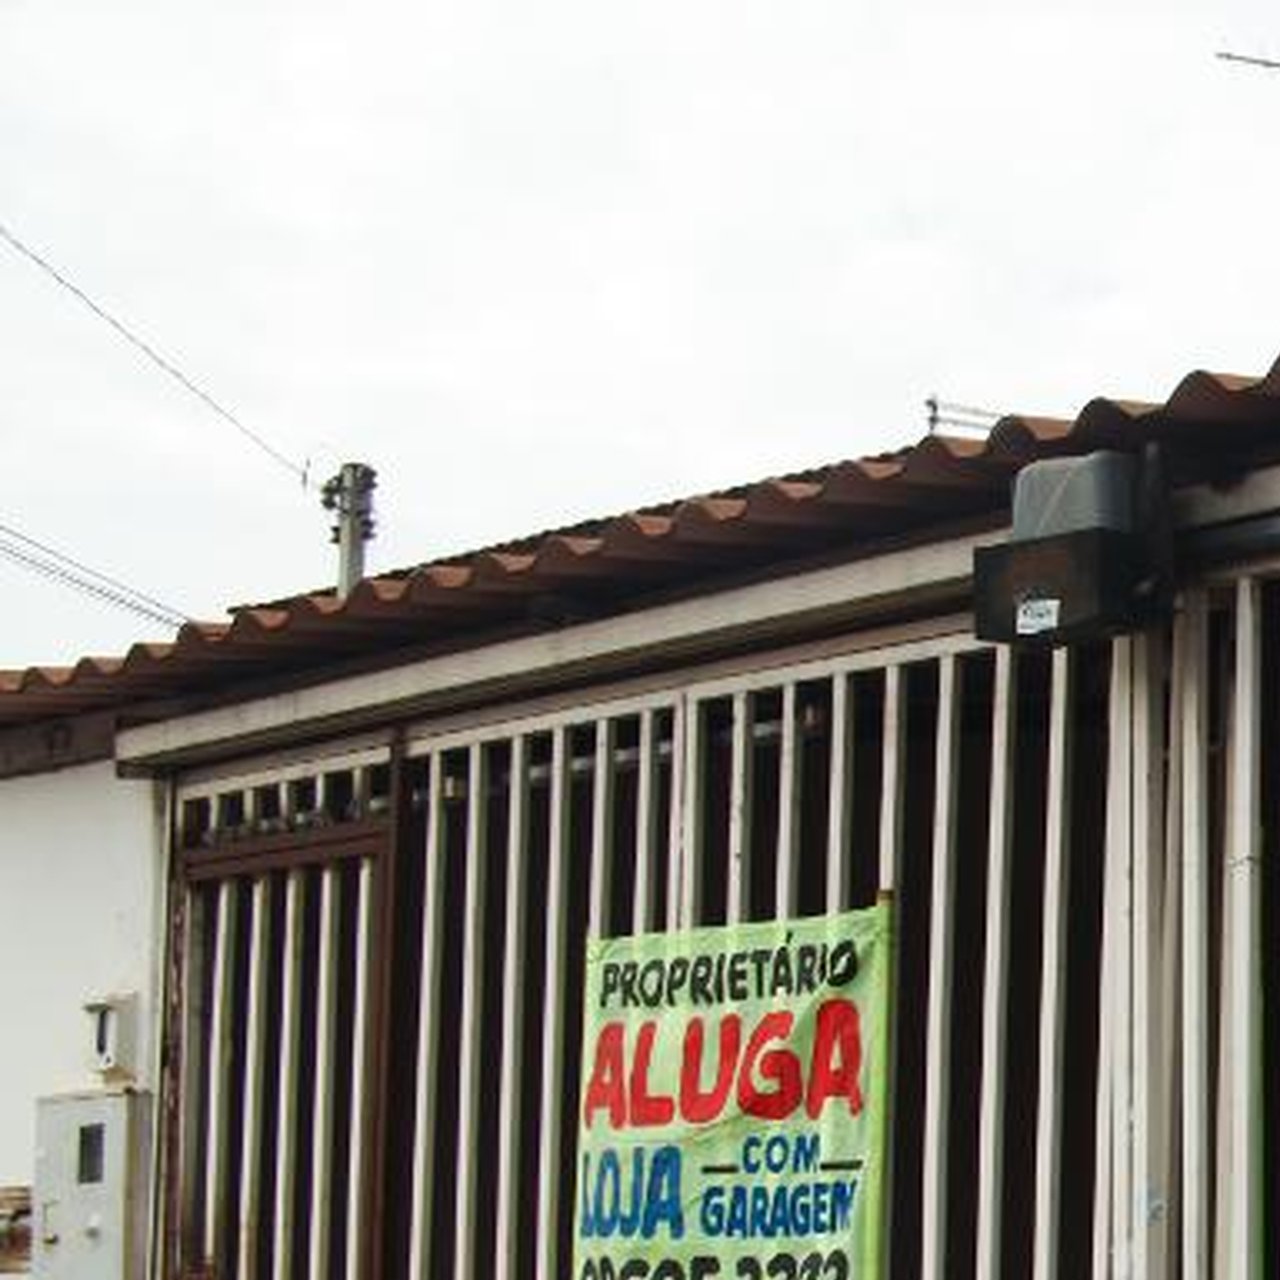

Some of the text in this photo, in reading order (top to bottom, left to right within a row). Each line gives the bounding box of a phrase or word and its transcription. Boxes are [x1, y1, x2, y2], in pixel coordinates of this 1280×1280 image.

[600, 932, 859, 1008] PROPRIETÁRIO
[584, 998, 864, 1130] ALUGA
[580, 1144, 685, 1240] LOJA
[742, 1134, 821, 1174] COM
